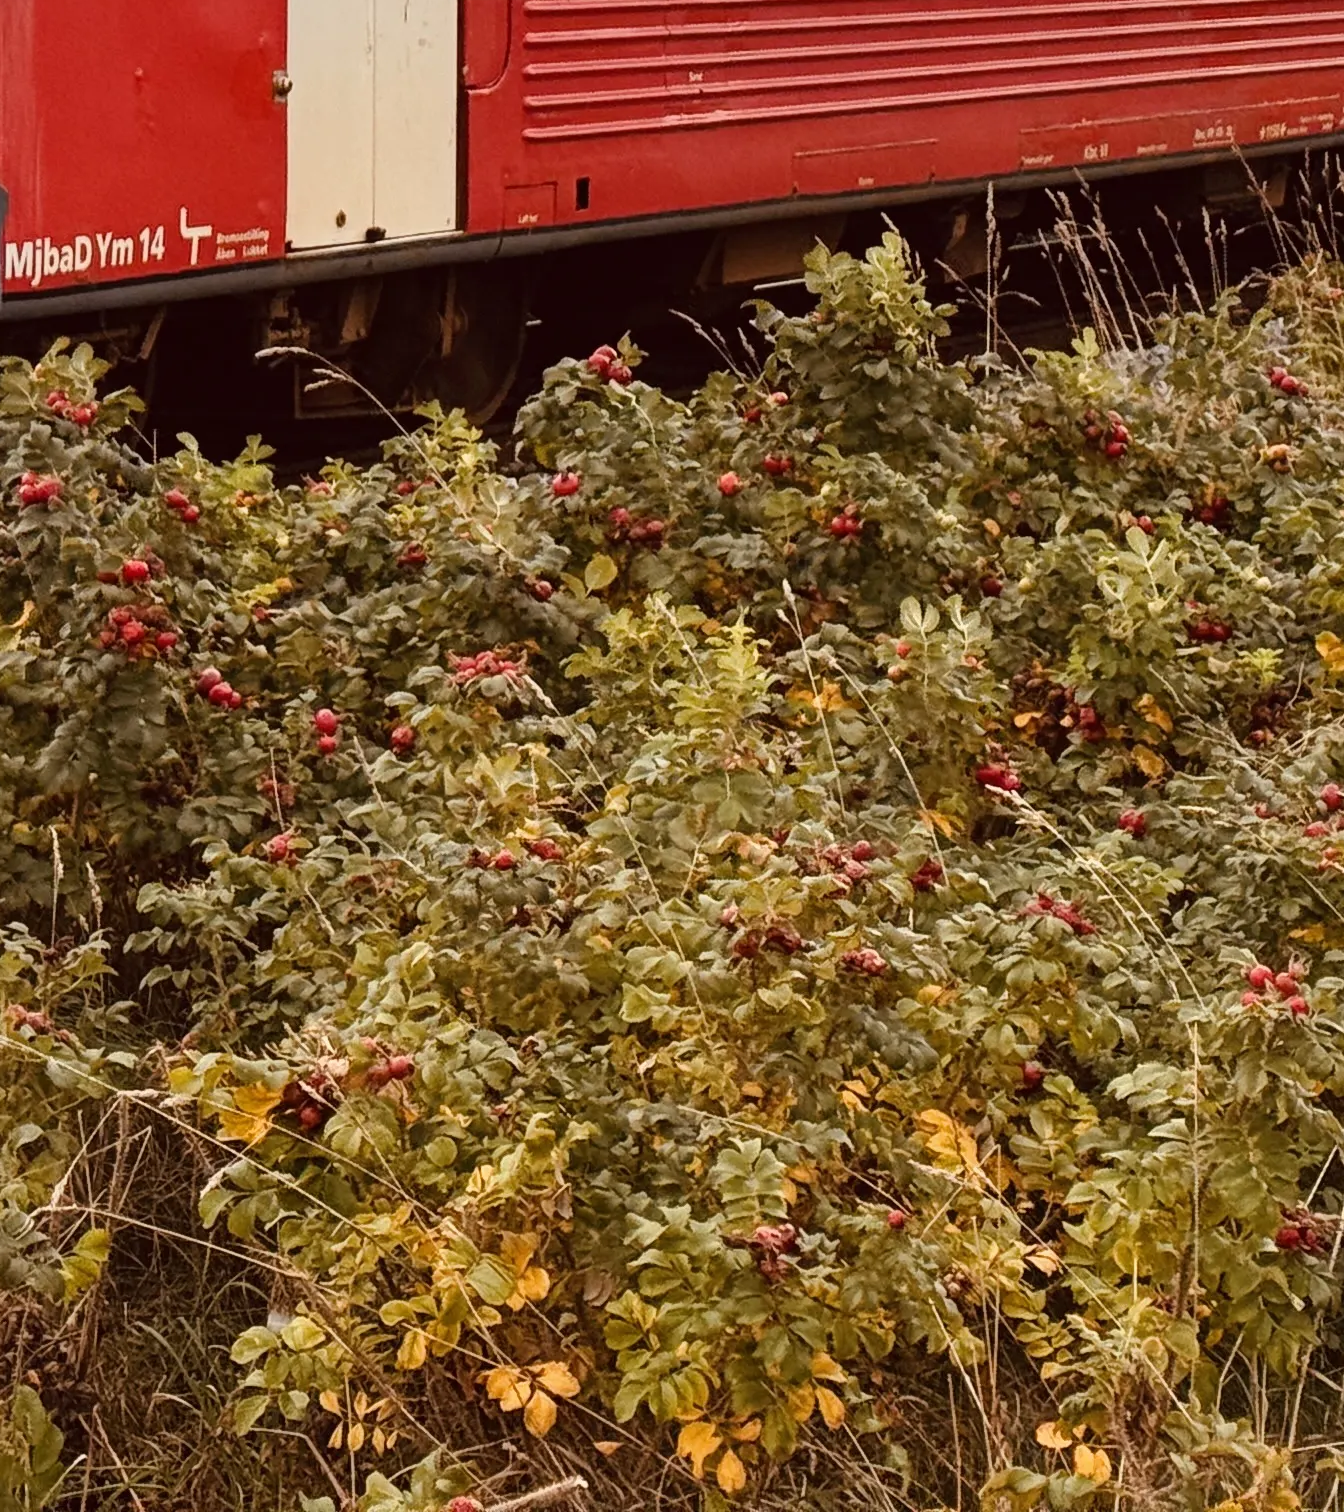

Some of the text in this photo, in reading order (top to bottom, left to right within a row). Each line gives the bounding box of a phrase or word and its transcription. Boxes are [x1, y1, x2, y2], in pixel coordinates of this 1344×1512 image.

[4, 225, 166, 288] MjbaD Ym 14
